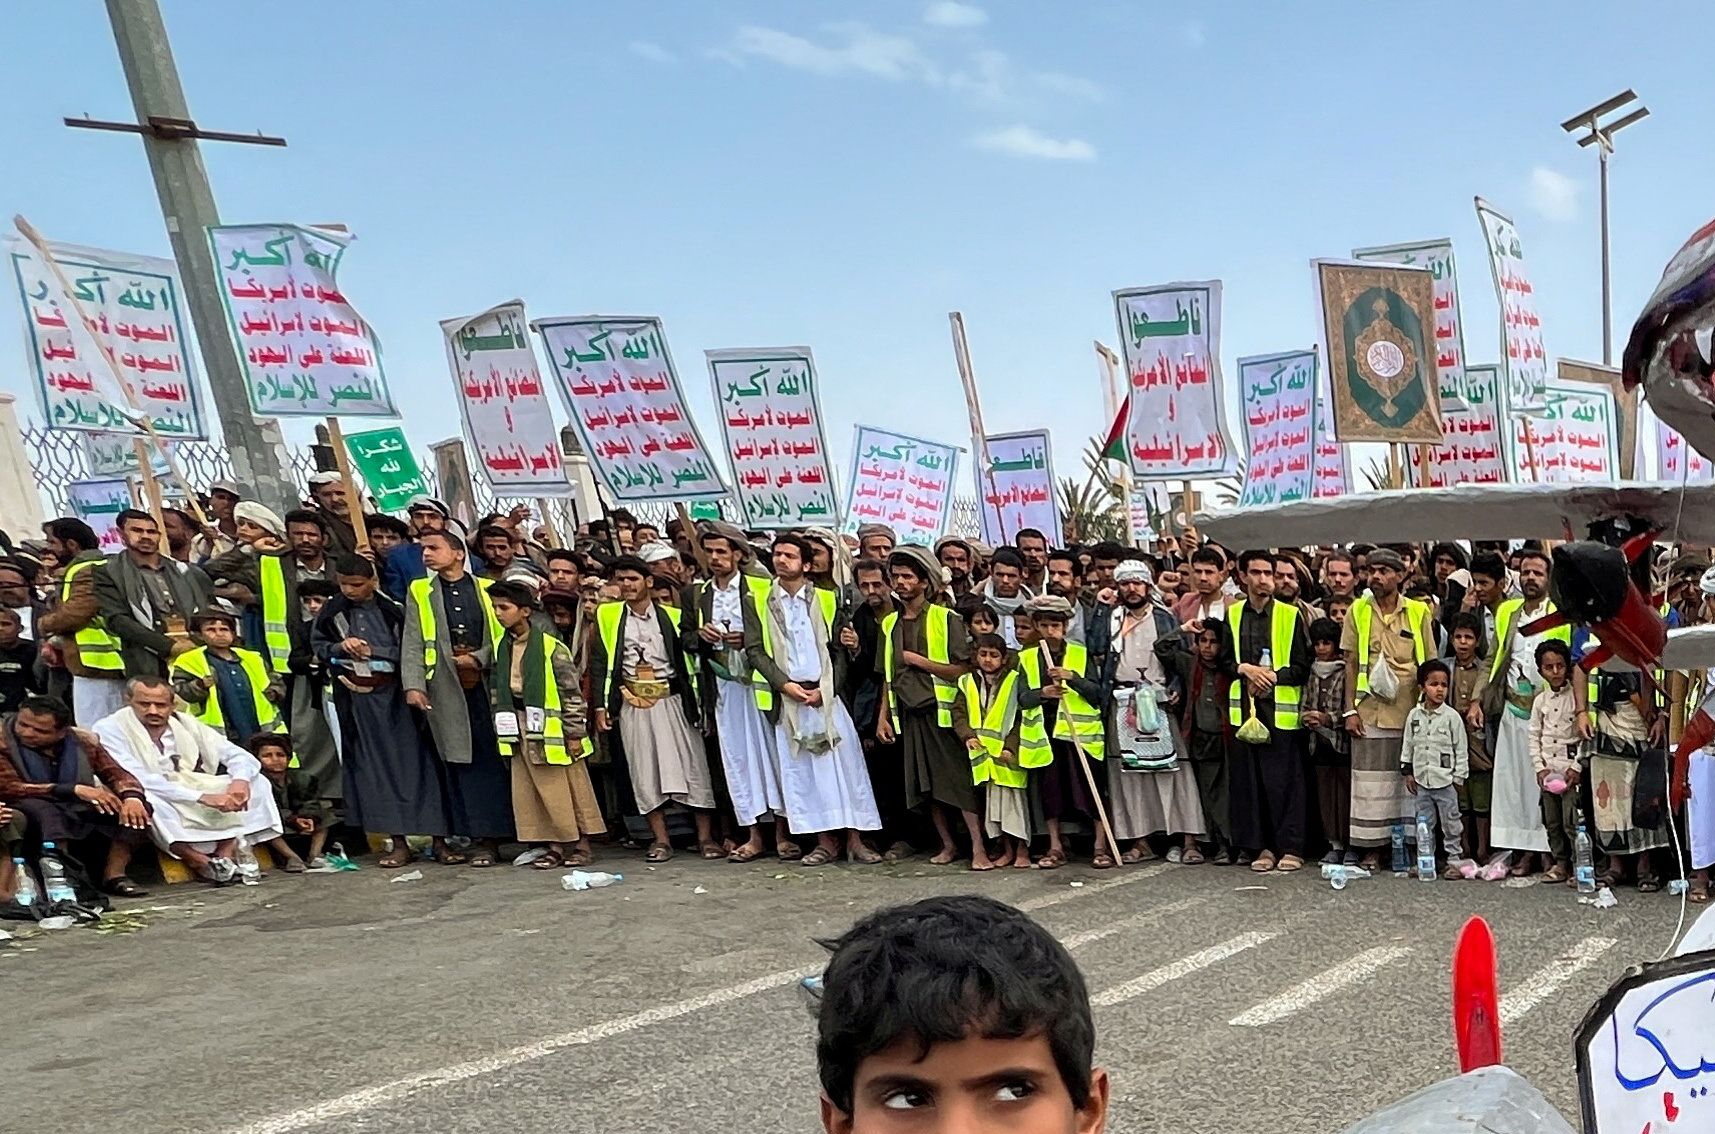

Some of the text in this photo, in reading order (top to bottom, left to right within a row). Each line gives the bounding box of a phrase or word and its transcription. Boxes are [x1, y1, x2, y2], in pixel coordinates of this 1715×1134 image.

[225, 231, 295, 275] أكبر
[117, 281, 169, 311] الله
[227, 276, 297, 303] لأمريكا
[115, 322, 176, 342] الموت
[240, 310, 367, 338] الموت لإسرائيل
[1125, 298, 1202, 349] قاطعوا
[121, 352, 181, 373] الموت
[249, 344, 375, 369] اللعنة على اليهود
[560, 324, 660, 373] الله أكبر
[257, 371, 383, 409] النصر للإسلام
[567, 368, 672, 399] الموت لأمريكا
[724, 364, 808, 406] الله أكبر
[1246, 363, 1313, 405] الله أكبر
[584, 403, 684, 432] الموت لإسرائيل
[725, 404, 814, 431] الموت لأمريكا
[1168, 393, 1175, 421] و
[1282, 398, 1311, 422] الموت
[1571, 400, 1604, 422] الله
[1281, 427, 1310, 450] الموت
[1458, 415, 1496, 436] الموت
[596, 432, 699, 460] اللعنة على اليهود
[734, 437, 820, 461] الموت لإسرائيل
[1132, 430, 1224, 468] الإسرائيلية
[1462, 442, 1499, 463] الموت
[1568, 432, 1605, 449] الموت
[862, 441, 949, 473] الله أكبر
[1570, 457, 1607, 473] الموت
[610, 457, 714, 493] النصر للإسلام
[741, 464, 826, 490] اللعنة على اليهود
[860, 462, 946, 494] الموت لأمريكا
[747, 490, 833, 524] النصر للإسلام
[856, 483, 943, 512] الموت لإسرائيل
[853, 503, 940, 531] اللعنة على اليهود
